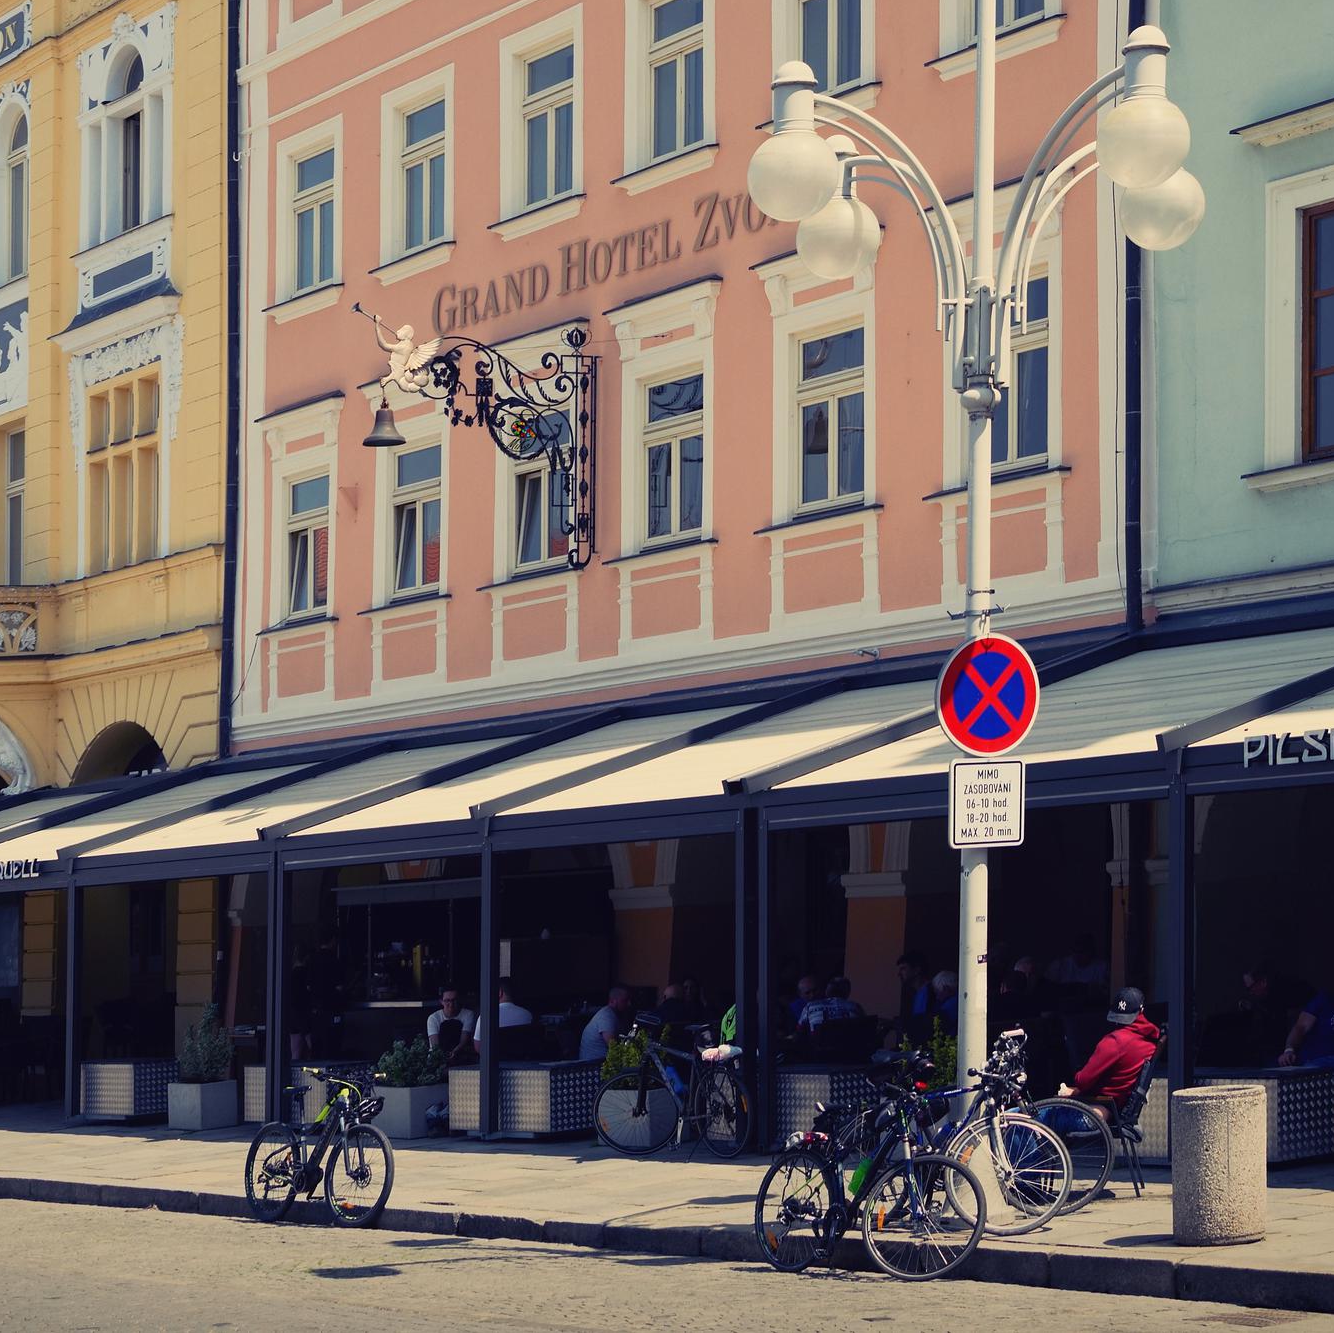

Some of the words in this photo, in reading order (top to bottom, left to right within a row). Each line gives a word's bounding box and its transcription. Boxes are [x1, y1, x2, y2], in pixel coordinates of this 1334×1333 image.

[432, 264, 549, 336] GRAND
[557, 218, 682, 296] HOTEL
[693, 192, 778, 253] ZVO
[977, 769, 999, 779] MIMO
[964, 781, 1011, 795] ZÁSOBOVÁNÍ
[966, 798, 989, 809] 06-10
[992, 798, 1009, 808] hod.
[967, 812, 989, 823] 18-20
[992, 812, 1009, 822] hod.
[961, 828, 980, 838] MAX.
[984, 827, 994, 837] 20
[997, 826, 1014, 836] min.
